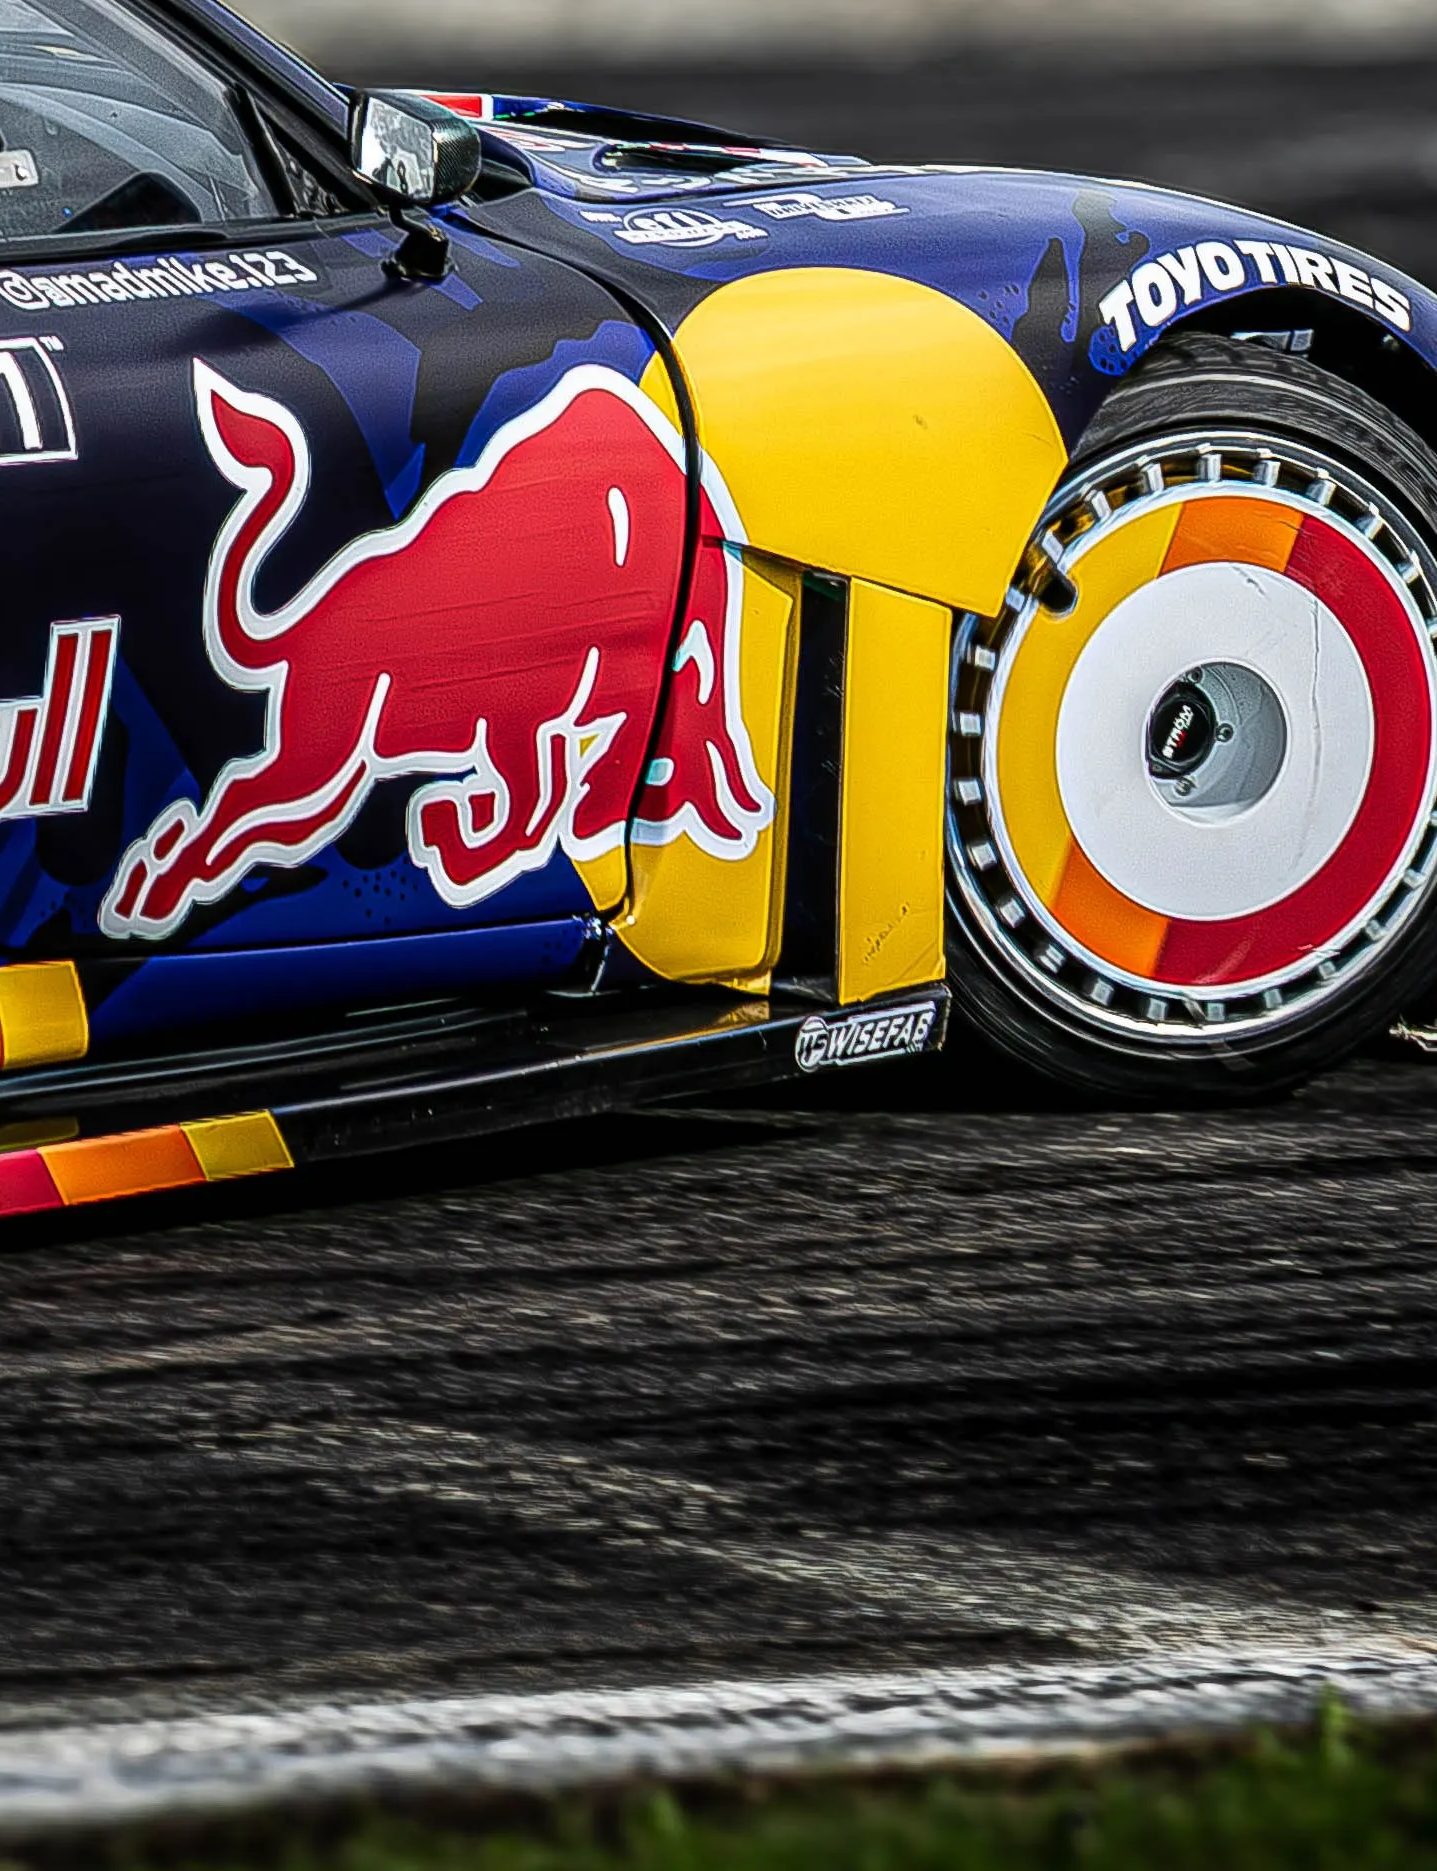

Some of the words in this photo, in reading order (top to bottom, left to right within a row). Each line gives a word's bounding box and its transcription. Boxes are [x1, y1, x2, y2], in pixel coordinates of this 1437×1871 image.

[1098, 240, 1246, 352] TOYO
[1235, 238, 1411, 331] TIRES
[827, 1010, 935, 1059] WISEFAB
